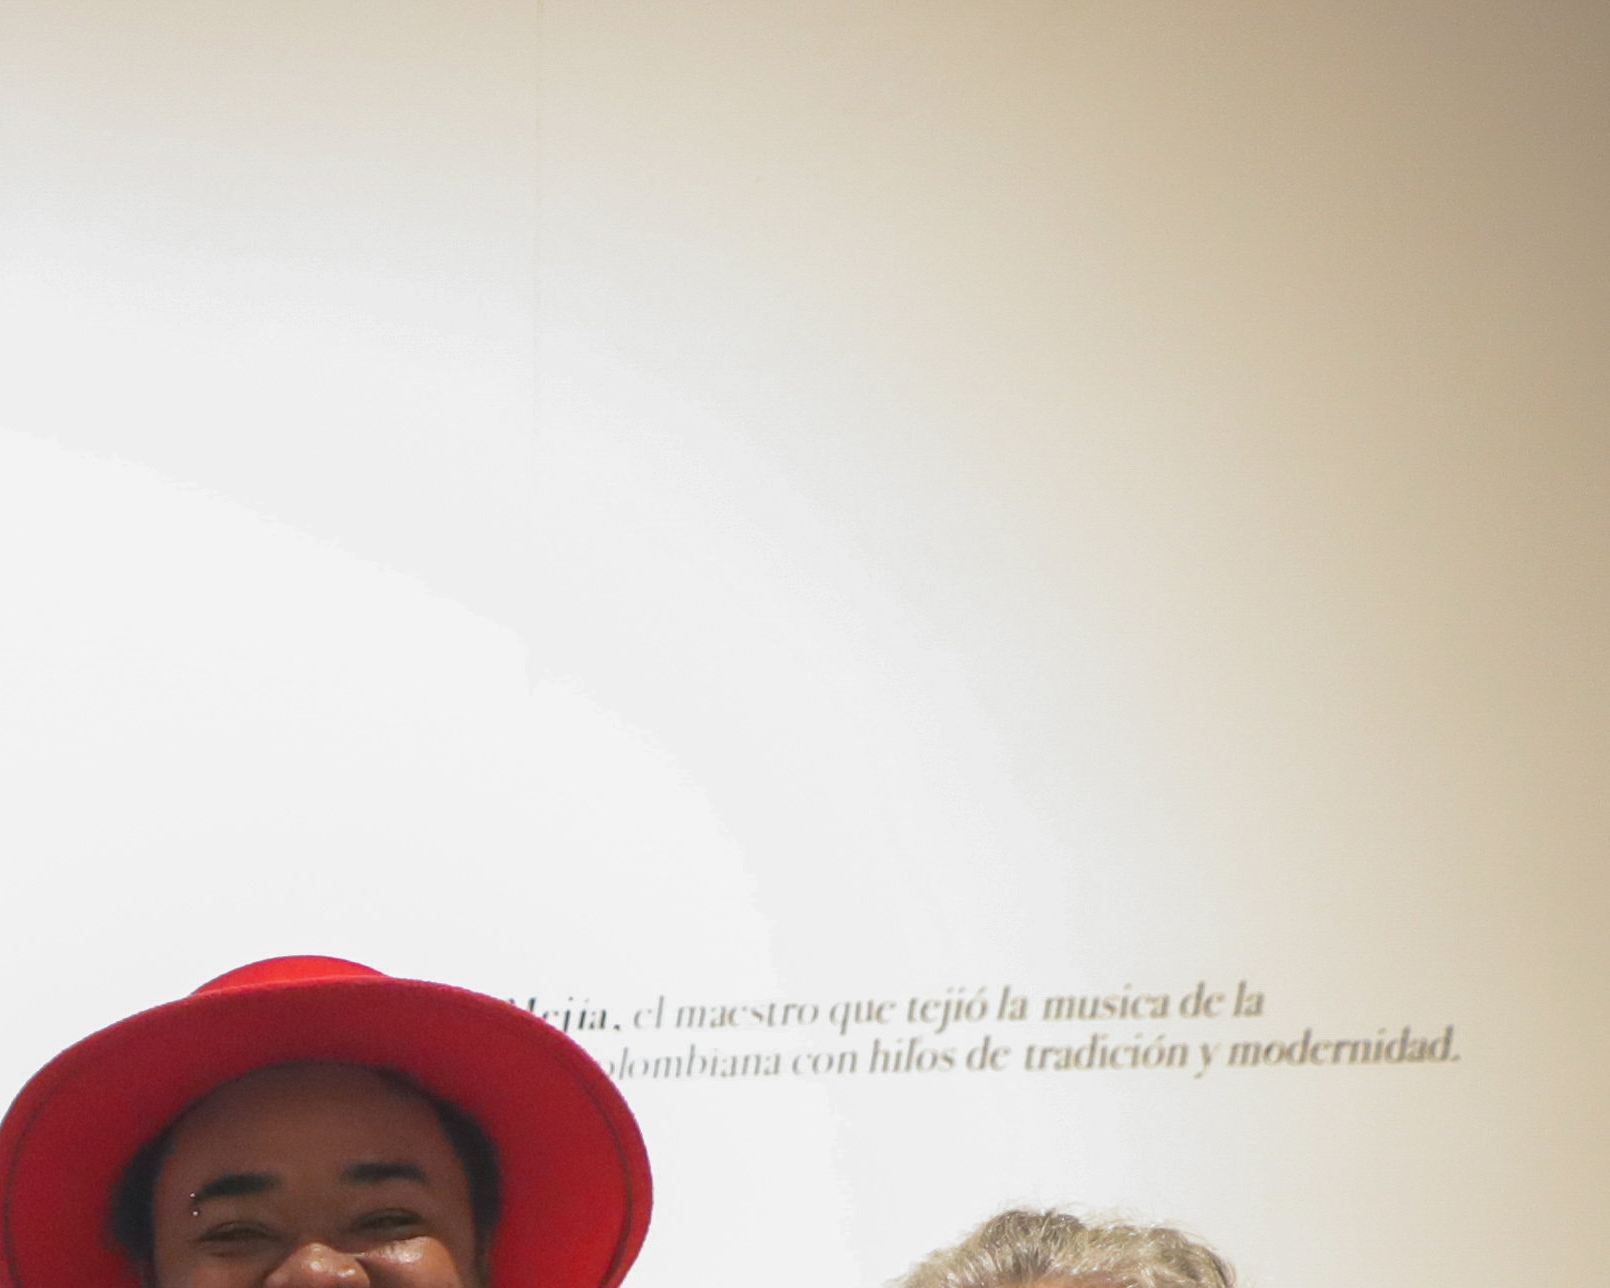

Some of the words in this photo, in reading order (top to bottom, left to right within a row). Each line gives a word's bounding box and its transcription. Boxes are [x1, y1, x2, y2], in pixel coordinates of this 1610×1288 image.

[633, 996, 664, 1029] el
[675, 1002, 819, 1028] maestro
[829, 1003, 895, 1036] que
[907, 985, 988, 1035] tejió
[997, 986, 1028, 1021] la
[1042, 983, 1171, 1022] musica
[1179, 981, 1224, 1018] de
[1233, 980, 1265, 1018] la
[600, 1044, 781, 1080] olombiana
[792, 1052, 858, 1076] con
[870, 1038, 956, 1074] hilos
[966, 1035, 1011, 1070] de
[1025, 1033, 1189, 1071] tradición
[1194, 1042, 1222, 1079] y
[1227, 1025, 1462, 1067] modernidad.
